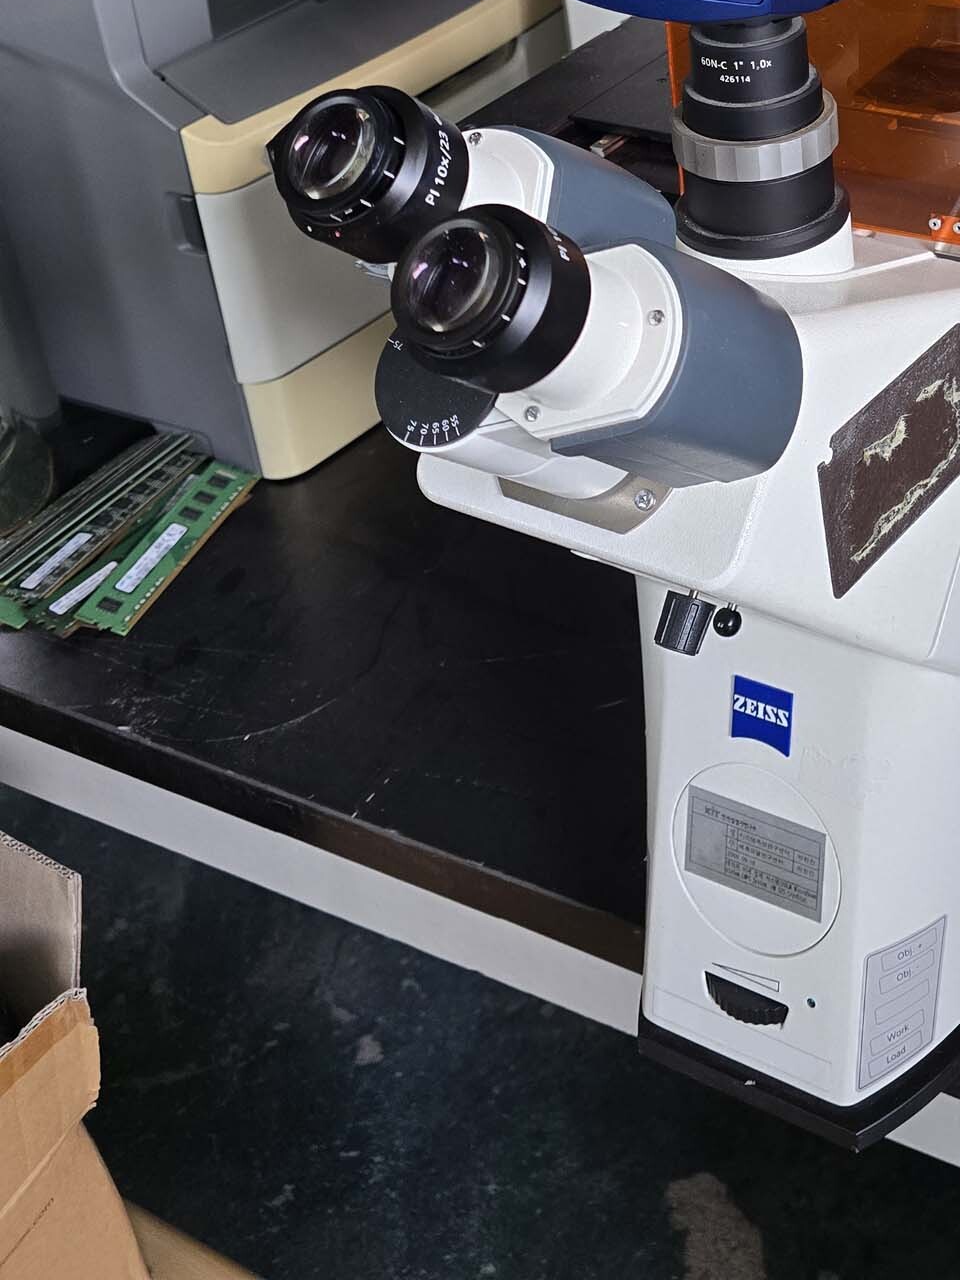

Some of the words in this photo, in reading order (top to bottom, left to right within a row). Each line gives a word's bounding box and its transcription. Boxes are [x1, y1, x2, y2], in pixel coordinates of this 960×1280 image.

[700, 56, 728, 70] 60N-C
[719, 74, 751, 83] 426114
[424, 188, 441, 207] PI
[434, 130, 452, 186] 10x/23
[407, 419, 417, 433] 75
[431, 422, 440, 434] 65
[441, 419, 450, 432] 60
[450, 414, 460, 428] 55
[420, 423, 429, 435] 70
[733, 693, 789, 728] ZEISS
[886, 1024, 910, 1043] Work
[886, 1047, 906, 1065] Load
